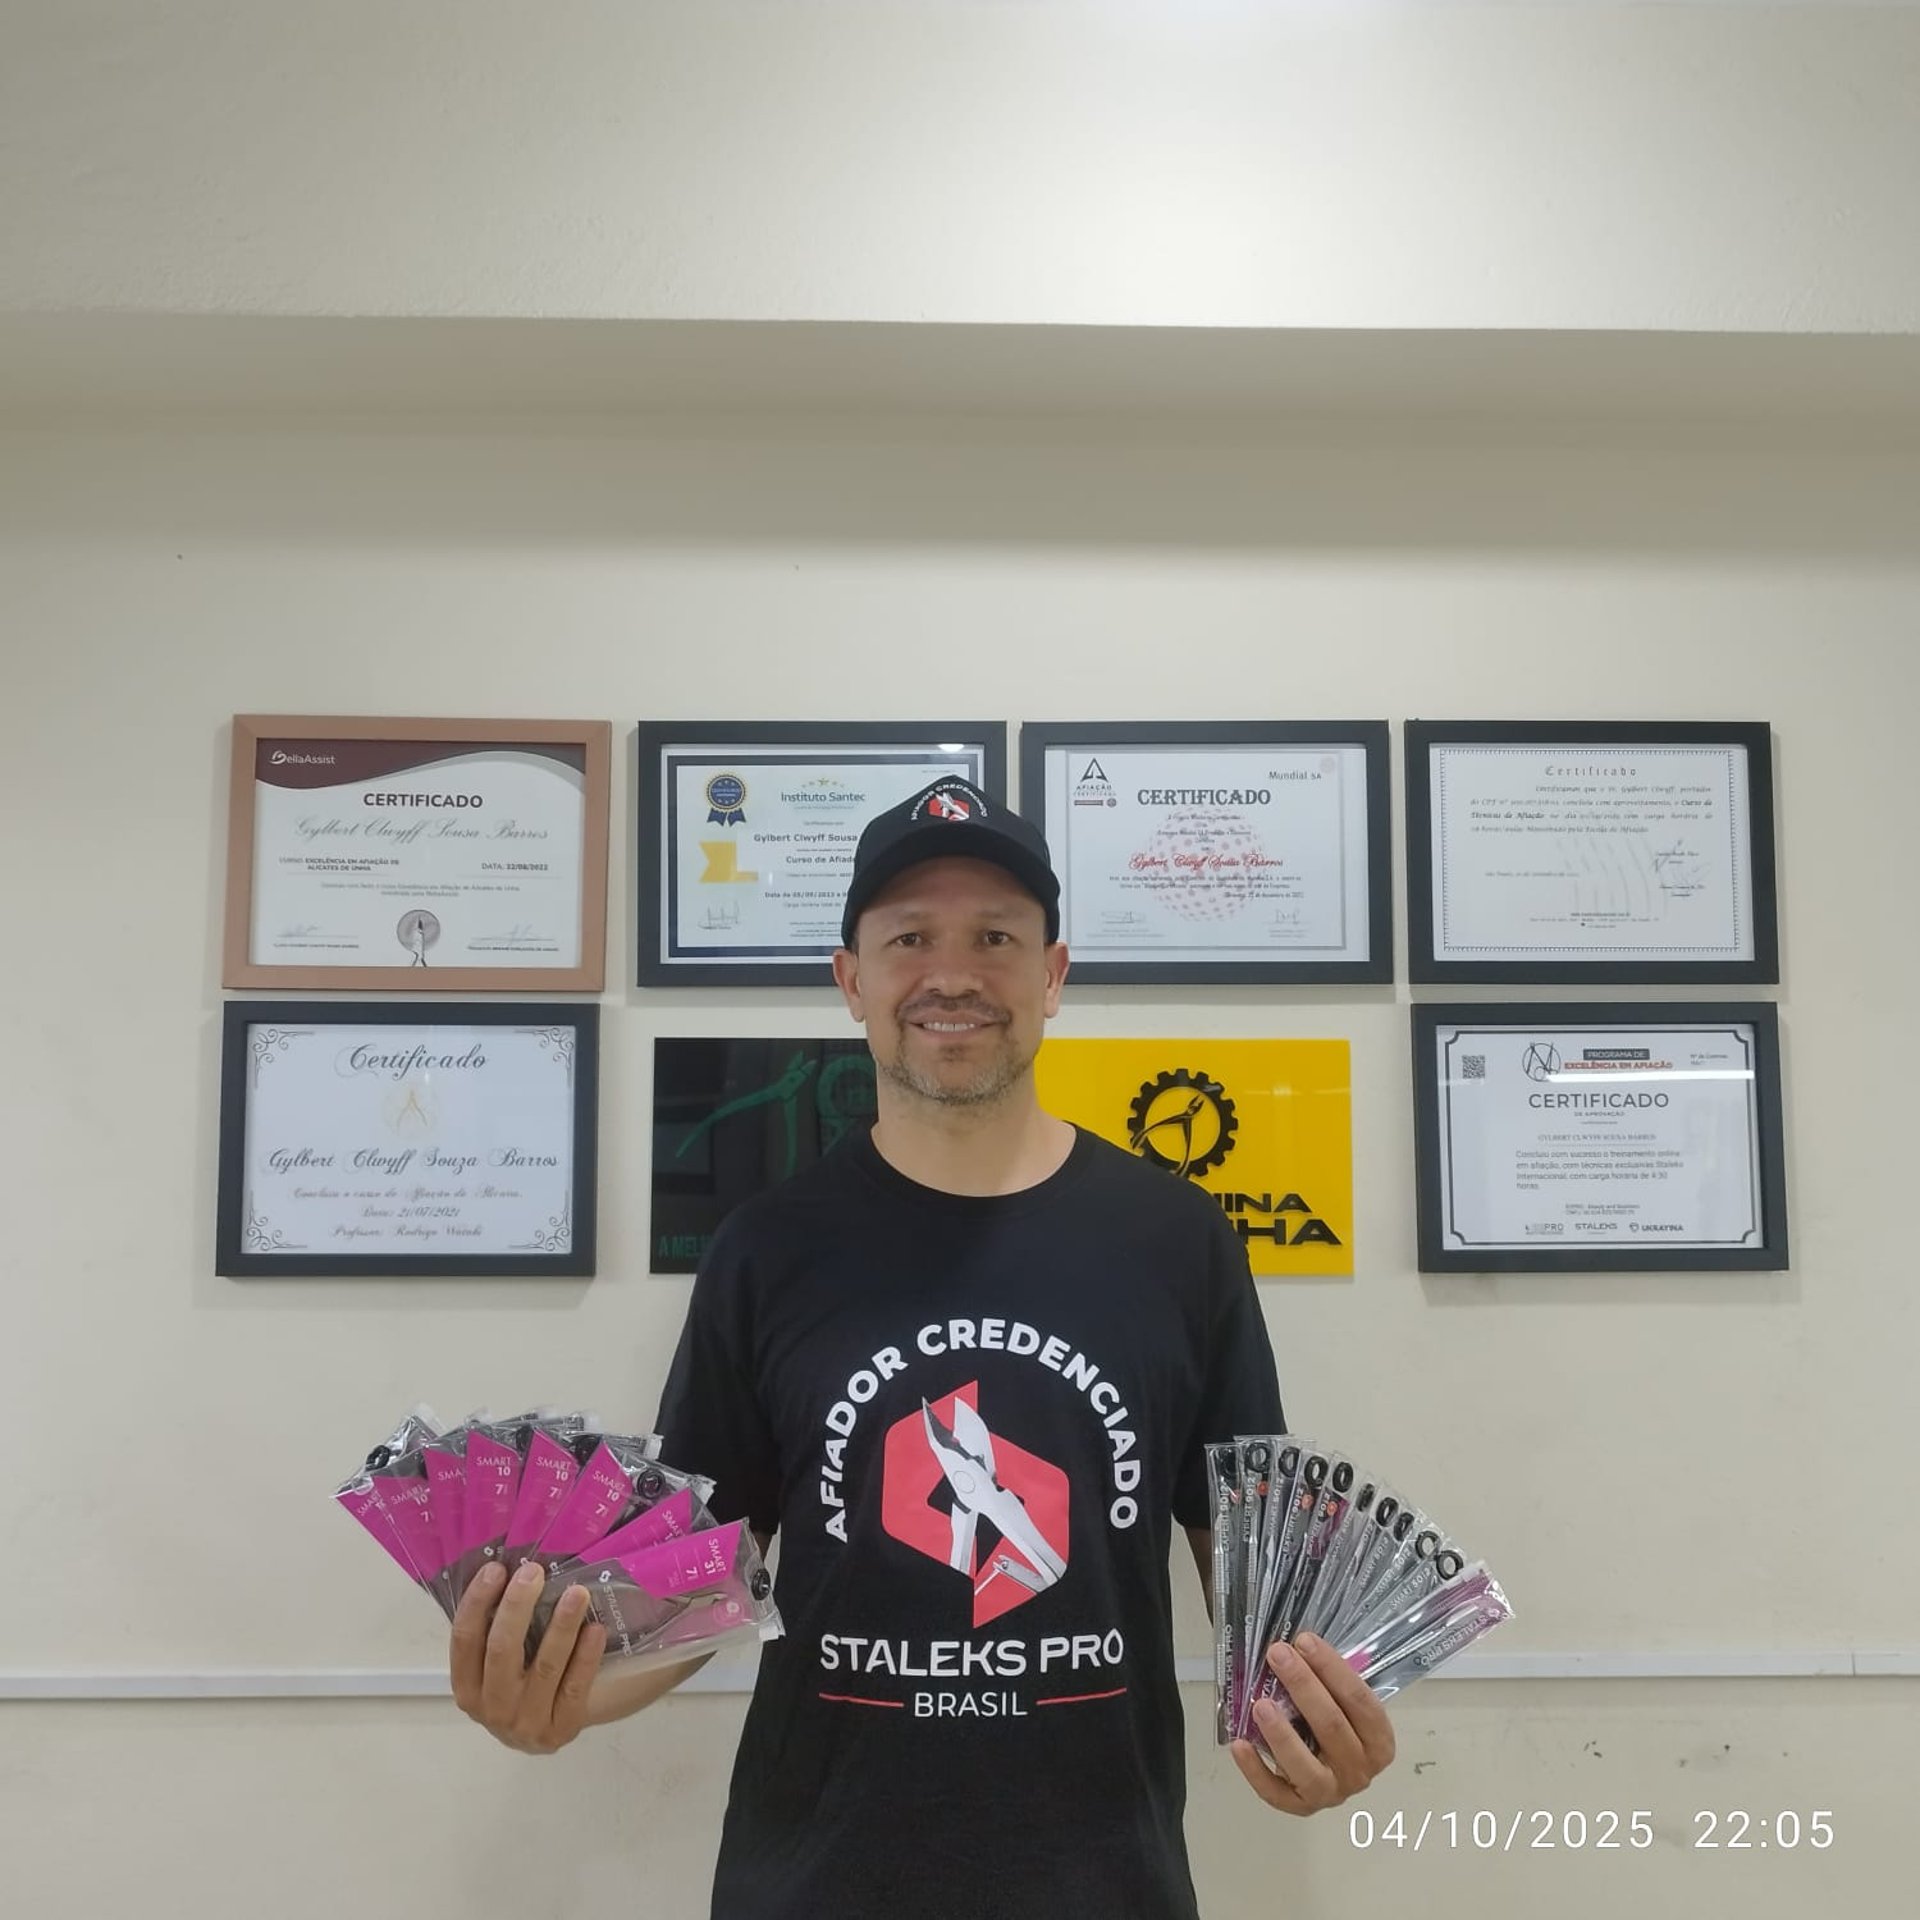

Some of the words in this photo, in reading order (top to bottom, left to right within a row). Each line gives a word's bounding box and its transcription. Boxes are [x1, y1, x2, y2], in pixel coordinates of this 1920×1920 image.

[1269, 771, 1307, 780] Mundial
[363, 793, 483, 808] CERTIFICADO
[781, 790, 827, 802] Instituto
[829, 791, 866, 802] Santec
[1137, 789, 1271, 806] CERTIFICADO
[754, 834, 791, 843] Gylbert
[794, 834, 825, 843] Clwyff
[828, 834, 858, 842] Sousa
[786, 856, 813, 864] Curso
[829, 856, 854, 864] Afiad
[337, 1043, 487, 1081] Certificado
[1587, 1050, 1632, 1059] PROGRAMA
[1634, 1050, 1647, 1059] DE
[1564, 1060, 1617, 1070] EXCELÊNCIA
[1619, 1062, 1633, 1070] EM
[1634, 1060, 1673, 1070] AFIAÇÃO
[1528, 1093, 1669, 1108] CERTIFICADO
[267, 1147, 336, 1174] Gylbert
[492, 1147, 557, 1167] Barros
[1211, 1193, 1312, 1213] INA
[1230, 1218, 1342, 1246] HA
[1575, 1222, 1618, 1231] STALEKS
[820, 1346, 908, 1543] AFIADOR
[917, 1318, 1141, 1529] CREDENCIADO
[475, 1456, 511, 1467] SMART
[535, 1456, 571, 1471] SMART
[497, 1466, 511, 1476] 10
[556, 1470, 569, 1481] 10
[592, 1470, 625, 1494] SMART
[391, 1484, 424, 1505] SMART
[414, 1494, 428, 1505] 10
[606, 1489, 620, 1501] 10
[1221, 1511, 1230, 1551] EXPERT
[708, 1538, 727, 1572] SMART
[704, 1561, 716, 1575] 31
[820, 1633, 1027, 1676] STALEKS
[1040, 1628, 1124, 1673] PRO
[914, 1692, 1027, 1717] BRASIL
